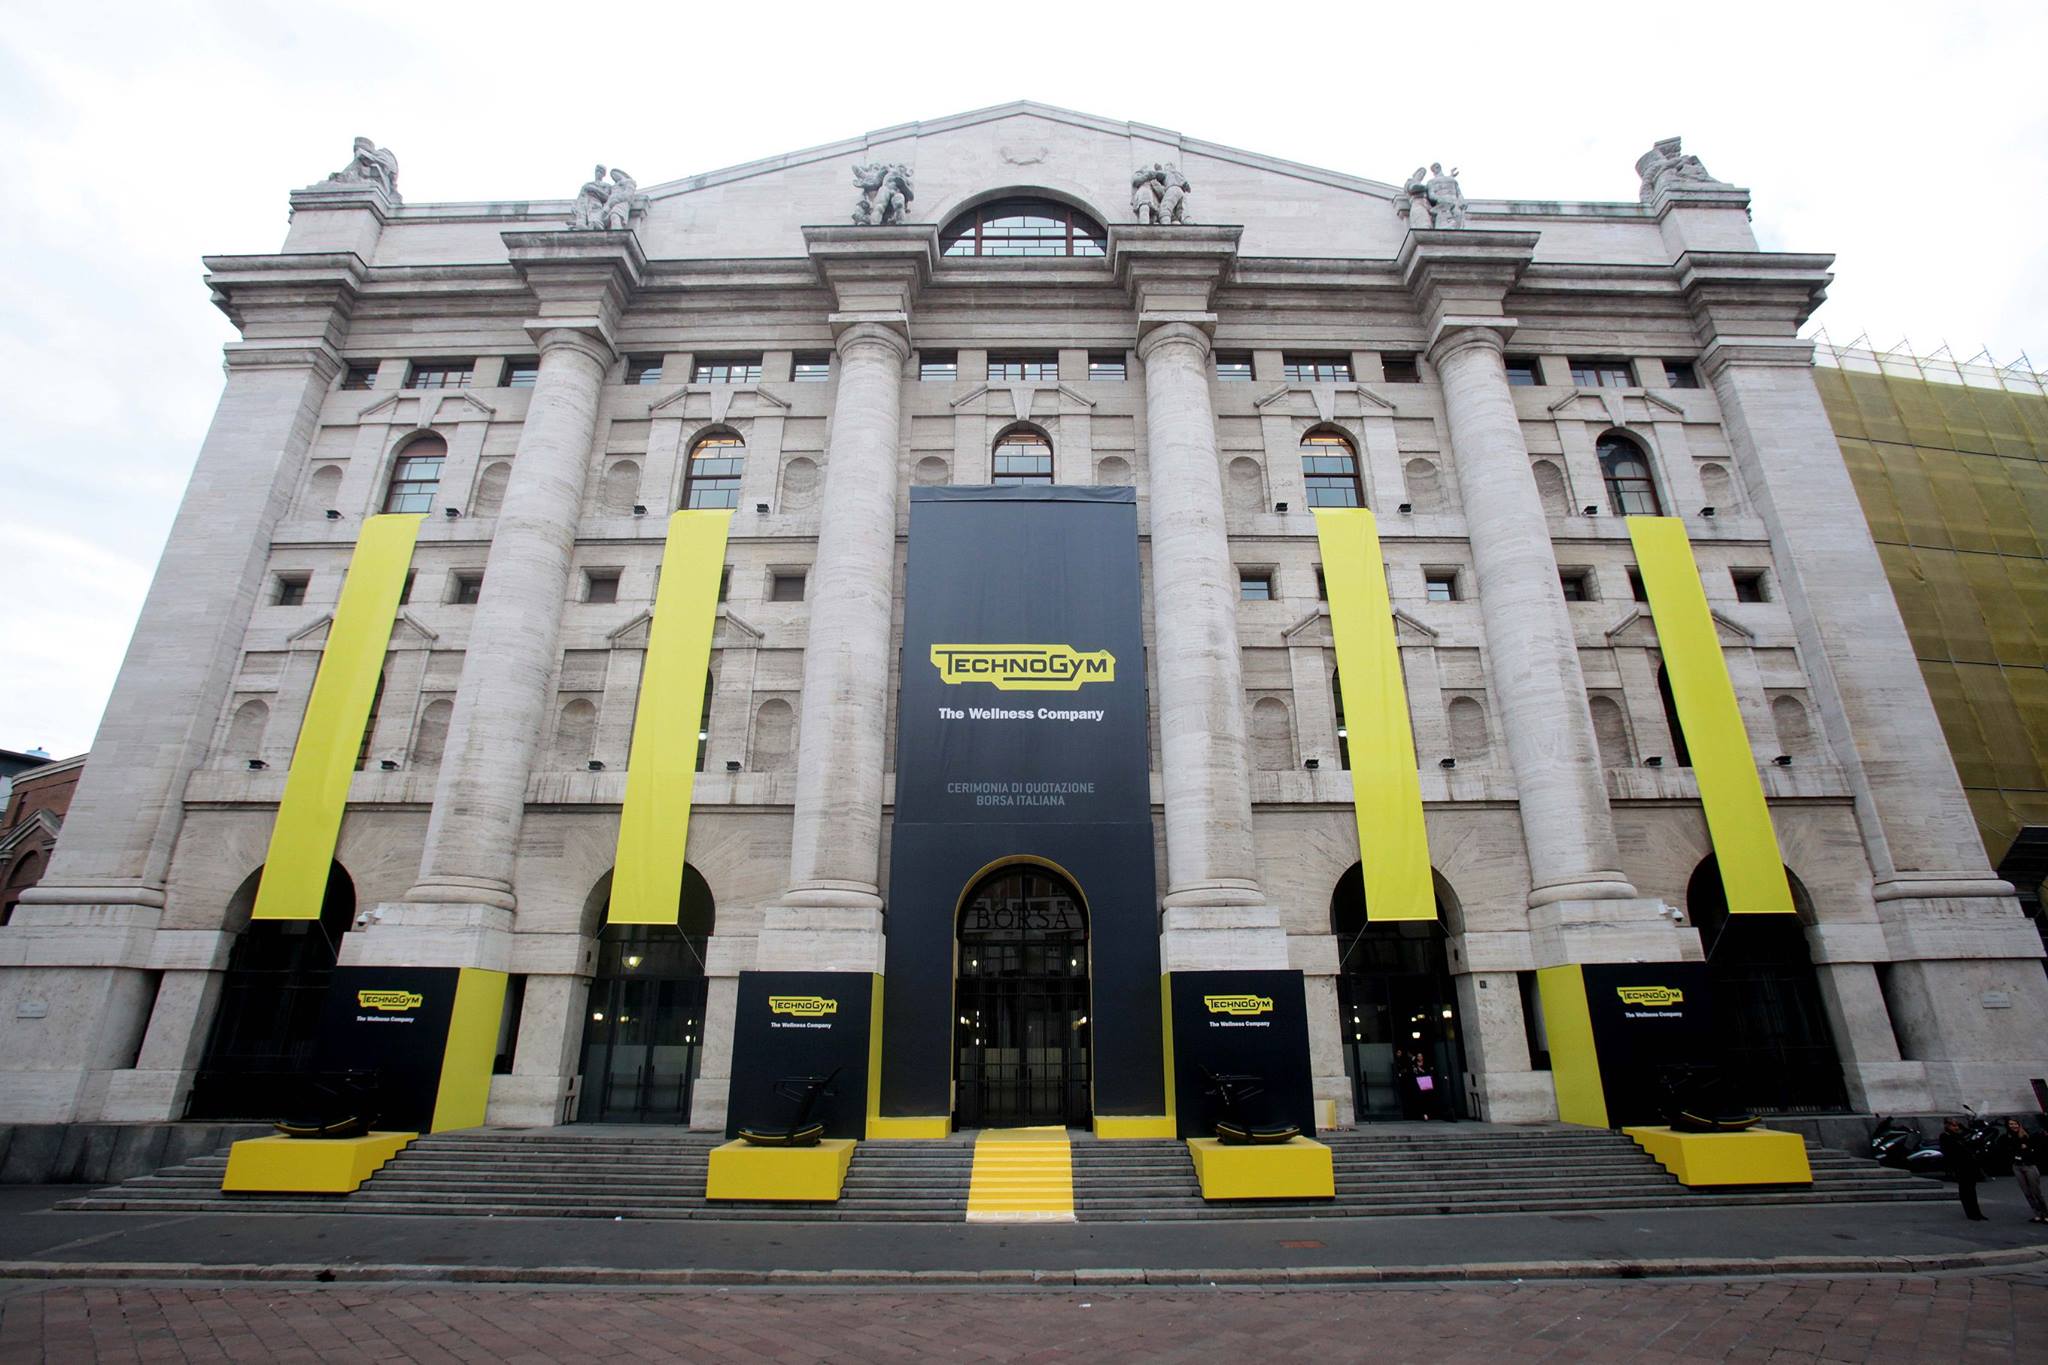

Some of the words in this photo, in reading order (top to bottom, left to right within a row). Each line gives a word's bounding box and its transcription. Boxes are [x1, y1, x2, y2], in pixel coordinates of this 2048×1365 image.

[938, 707, 965, 720] The
[969, 707, 1034, 720] Wellness
[1037, 707, 1105, 722] Company
[947, 782, 1009, 794] CERIMONIA
[1012, 782, 1023, 794] DI
[1026, 782, 1095, 794] QUOTAZIONE
[976, 795, 1014, 807] BORSA
[1016, 795, 1065, 807] ITALIANA
[976, 908, 1070, 929] BORSA
